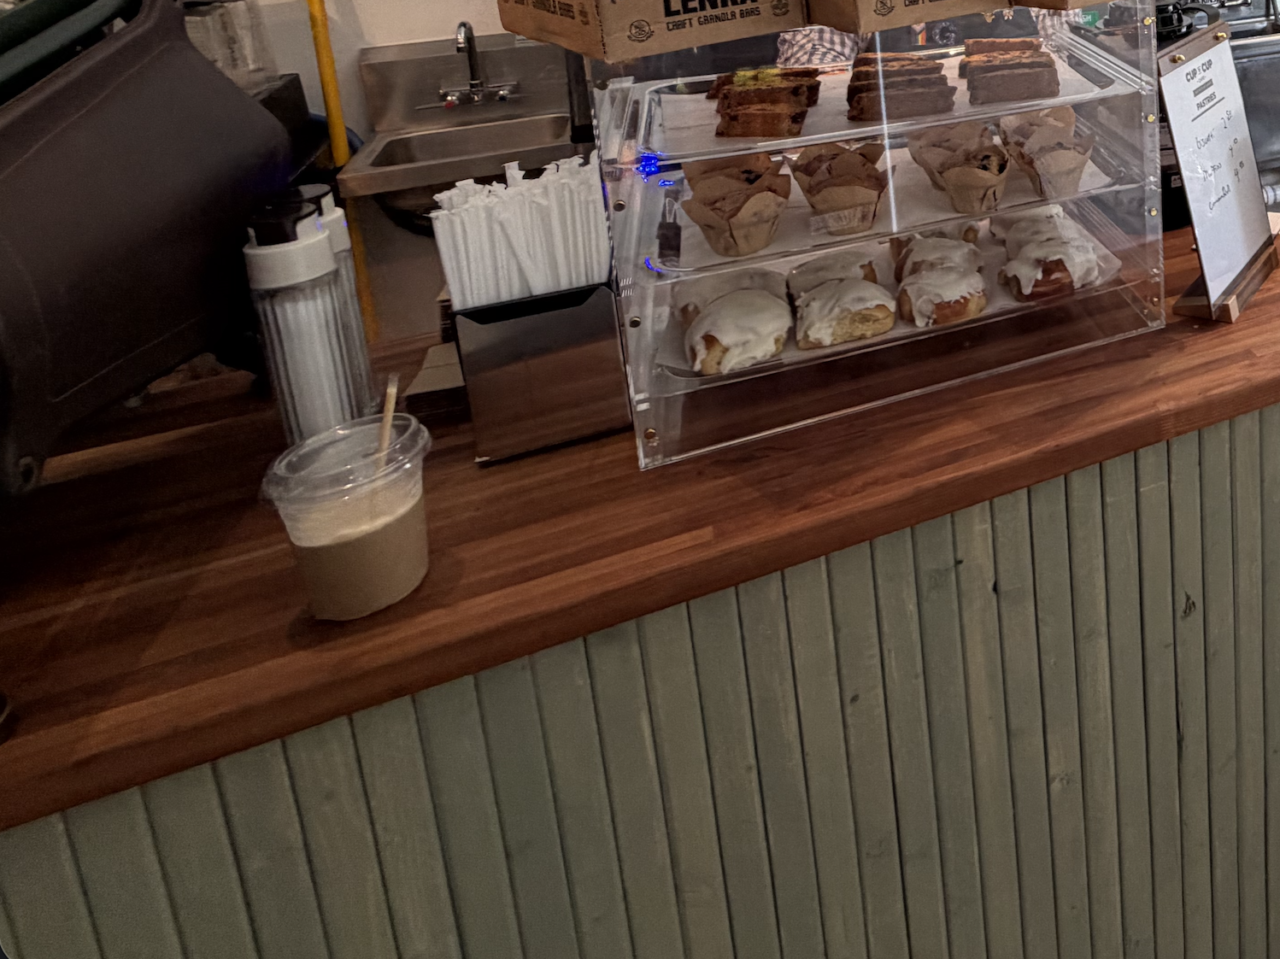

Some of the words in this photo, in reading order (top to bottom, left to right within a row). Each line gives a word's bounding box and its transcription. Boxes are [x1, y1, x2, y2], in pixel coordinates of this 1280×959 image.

[666, 18, 693, 32] CRAFT
[697, 10, 736, 26] GRANOLA
[739, 6, 761, 20] BARS
[1196, 91, 1217, 111] PASTRIES
